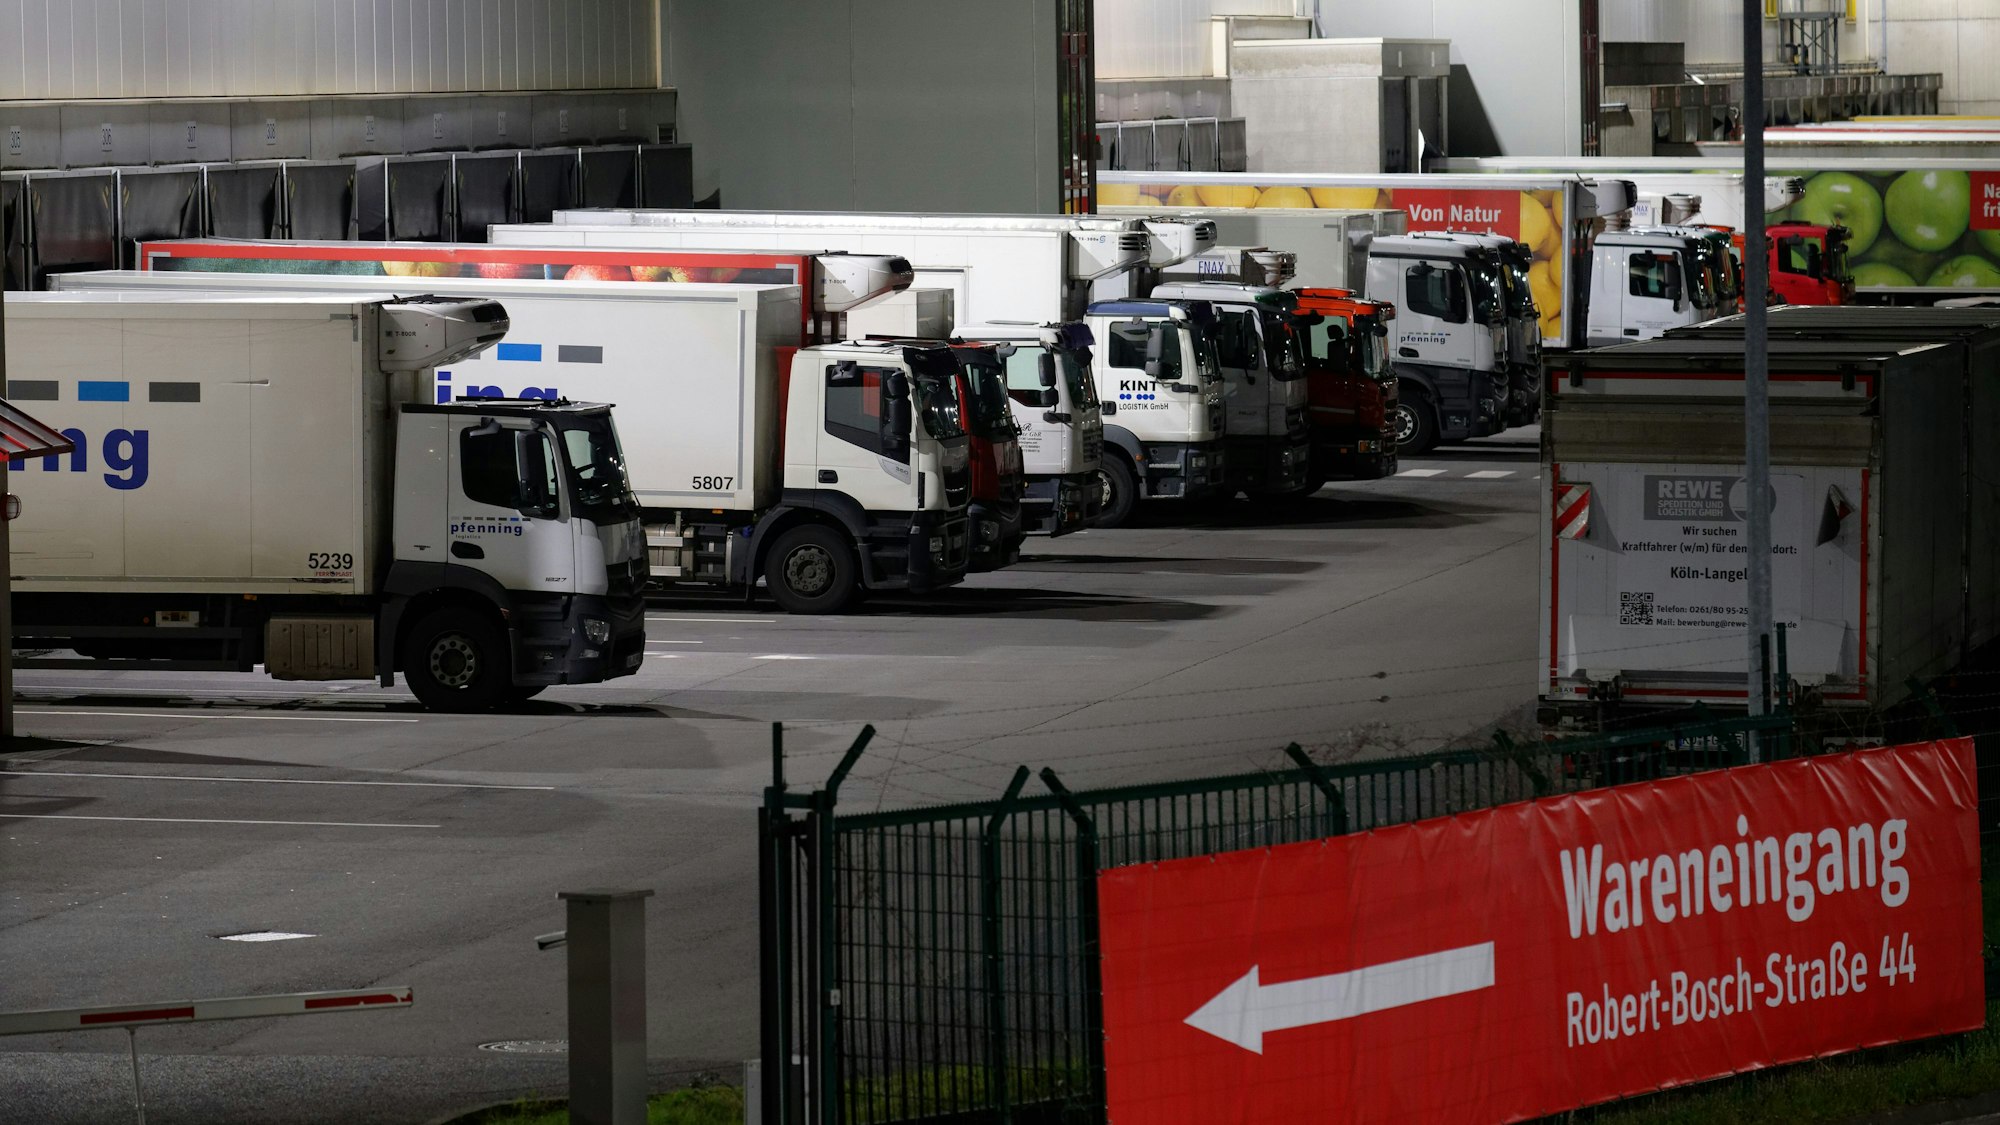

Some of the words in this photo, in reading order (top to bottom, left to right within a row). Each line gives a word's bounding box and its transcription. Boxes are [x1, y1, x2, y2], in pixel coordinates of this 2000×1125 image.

[1409, 204, 1444, 222] Von
[1450, 204, 1501, 222] Natur
[1400, 335, 1446, 345] pfenning
[1120, 380, 1157, 392] KINT
[1150, 402, 1169, 410] GmbH
[9, 428, 149, 490] ng
[692, 476, 734, 490] 5807
[1658, 480, 1723, 499] REWE
[1657, 500, 1703, 509] SPEDITION
[1705, 501, 1724, 509] UND
[1657, 508, 1697, 516] LOGISTIK
[1699, 509, 1723, 517] GMBH
[451, 522, 522, 537] pfenning
[1682, 526, 1700, 536] Wir
[1702, 526, 1737, 536] suchen
[1622, 542, 1677, 552] Kraftfahrer
[1680, 542, 1709, 554] (w/m)
[1712, 542, 1726, 553] für
[1729, 544, 1747, 553] den
[308, 553, 353, 570] 5239
[1670, 566, 1748, 582] Köln-Langel
[1656, 605, 1688, 613] Telefon:
[1689, 605, 1724, 615] 0261/80
[1656, 618, 1675, 627] Mail:
[1559, 814, 1910, 939] Wareneingang
[1566, 941, 1868, 1048] Robert-Bosch-Straße
[1879, 932, 1917, 987] 44
